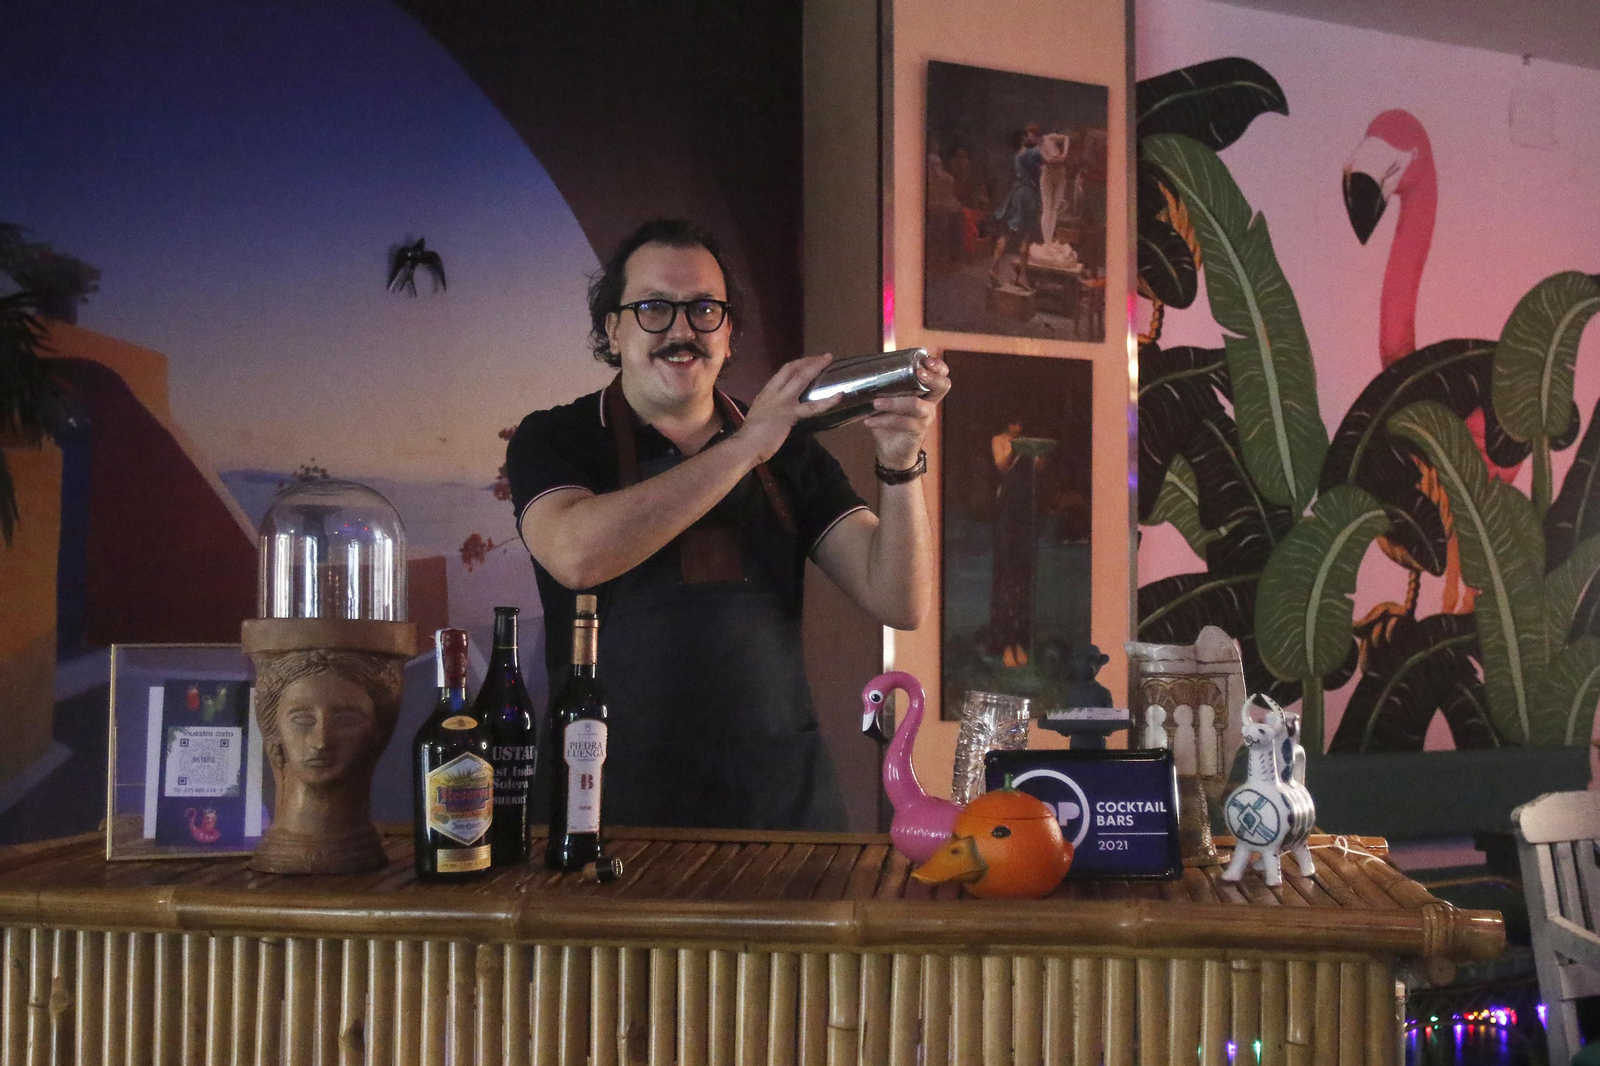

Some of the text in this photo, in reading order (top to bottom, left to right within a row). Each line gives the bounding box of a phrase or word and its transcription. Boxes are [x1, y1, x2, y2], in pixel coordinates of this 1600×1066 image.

[569, 741, 603, 750] PIEDRA
[492, 745, 536, 760] USTAU
[567, 749, 604, 758] LUENGA
[493, 779, 529, 789] Solera
[580, 774, 594, 790] B
[1096, 801, 1167, 813] COCKTAIL
[1096, 815, 1134, 827] BARS
[1098, 840, 1129, 851] 2021
